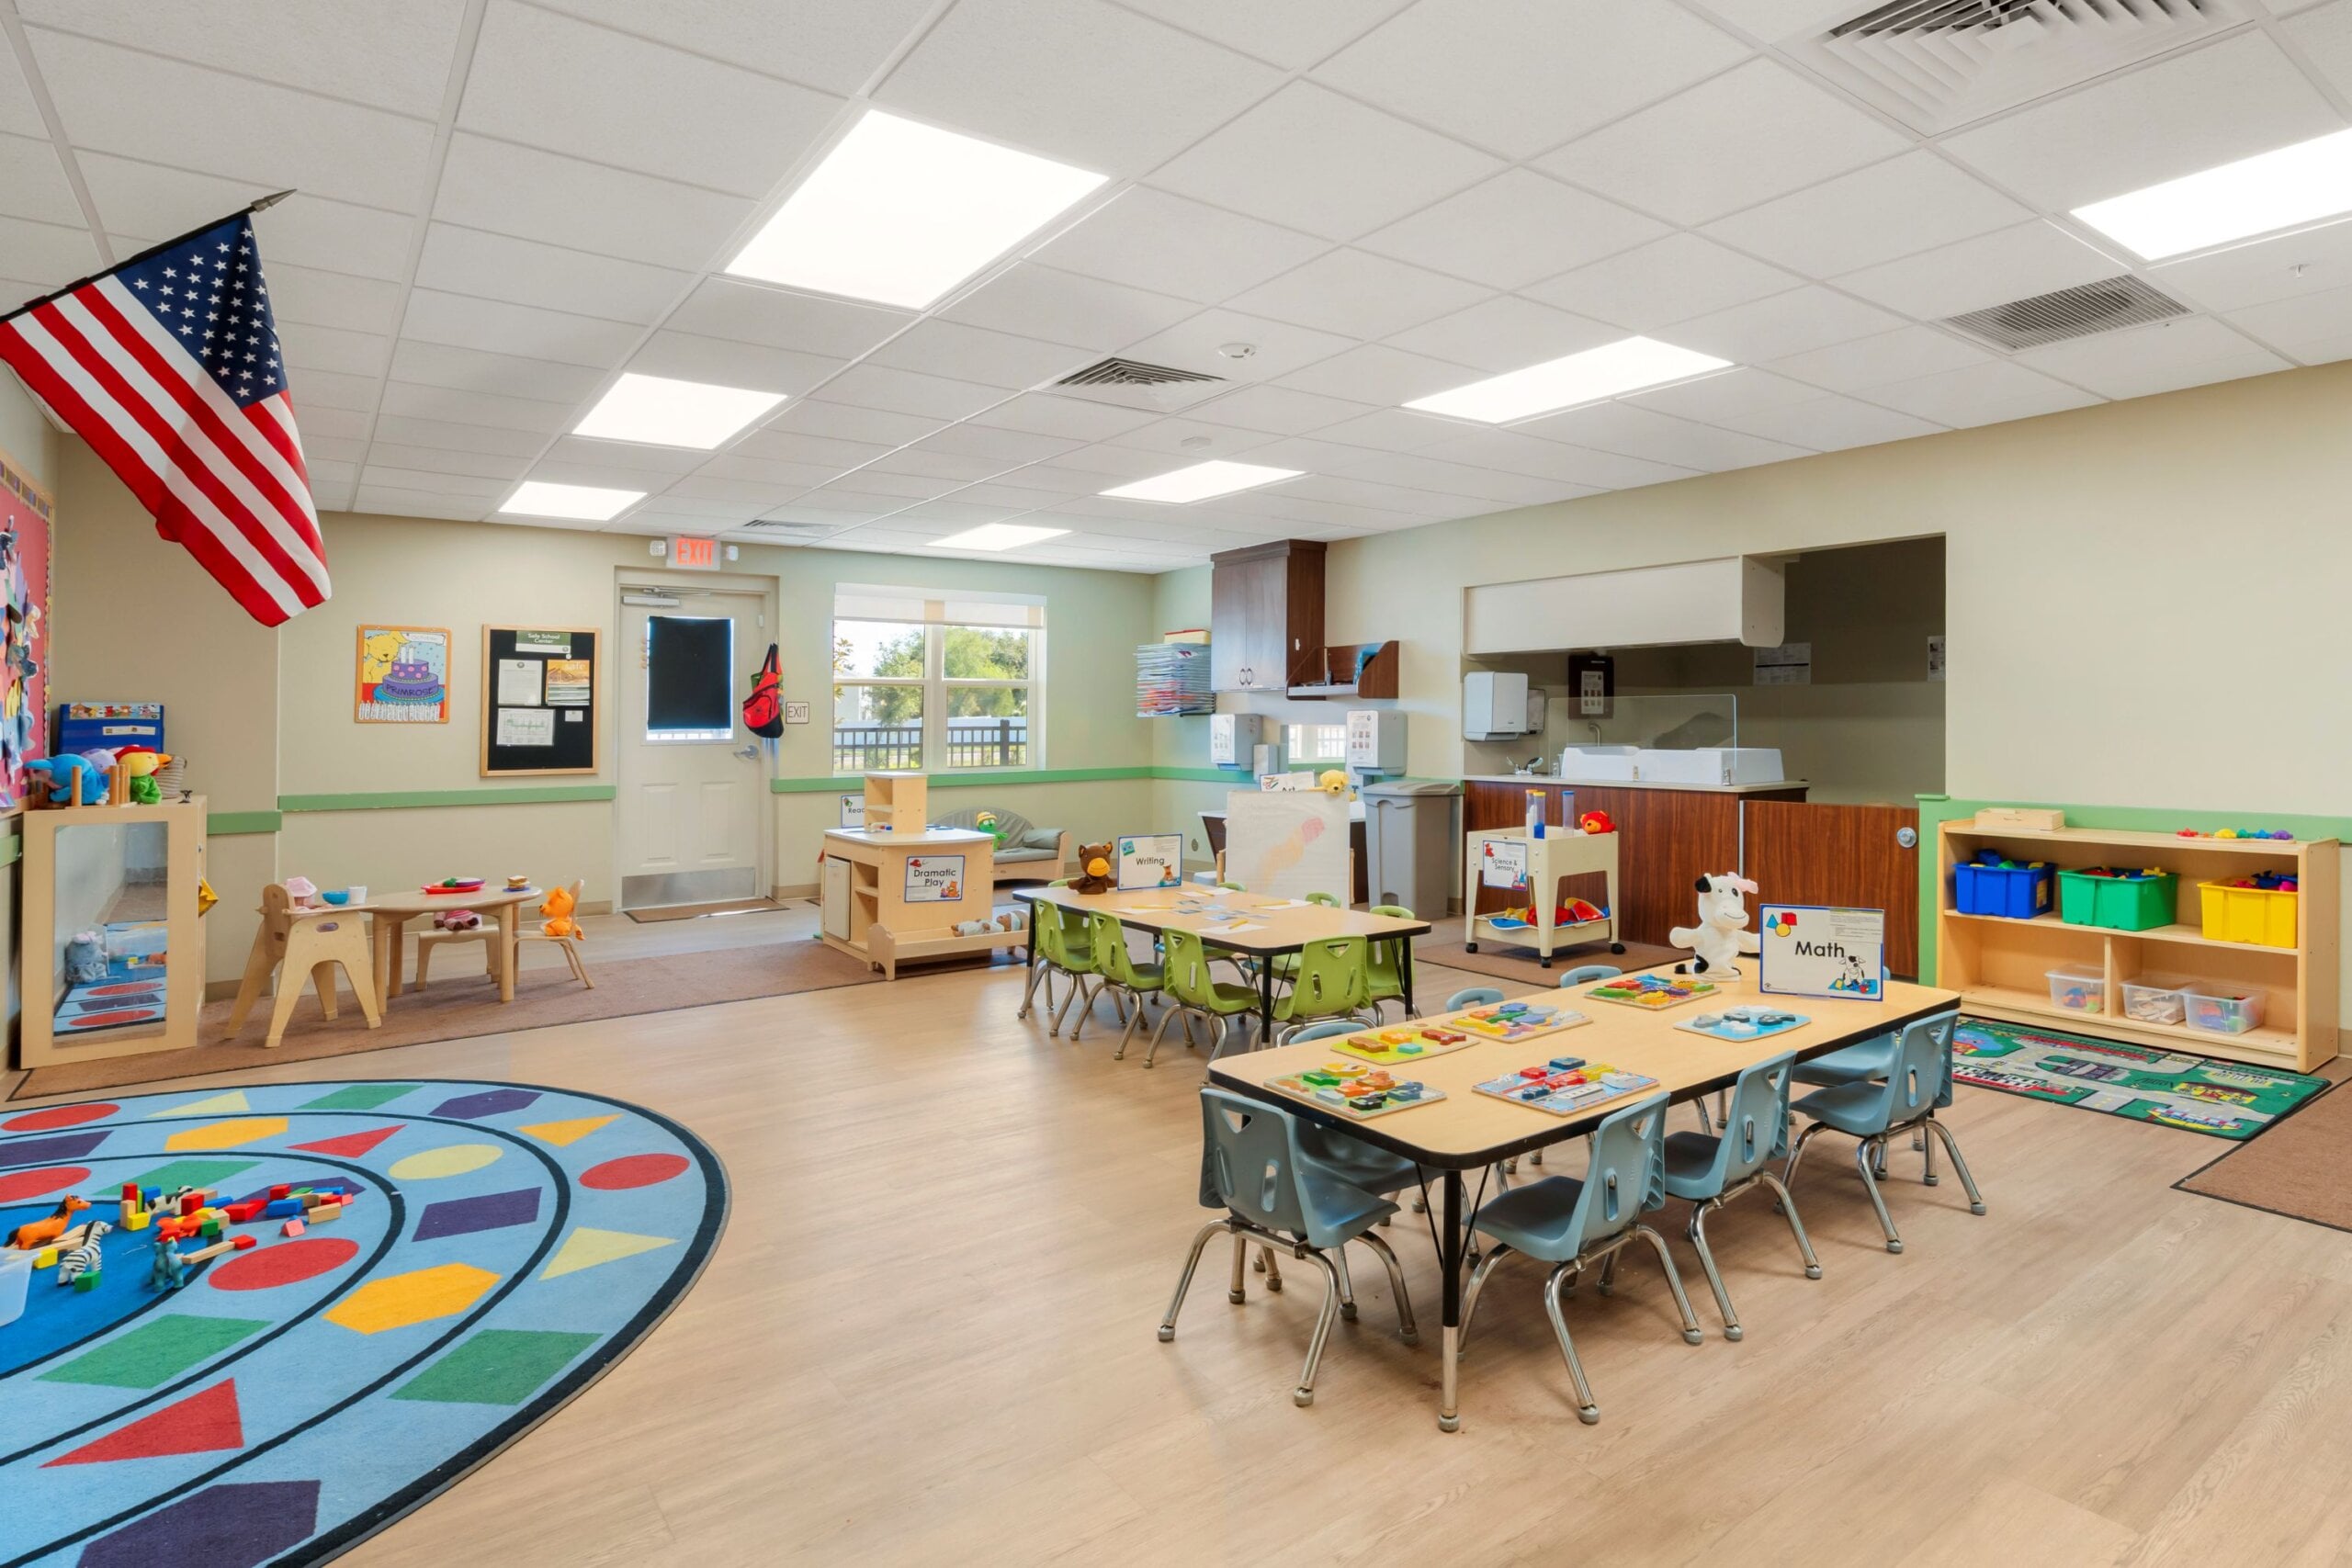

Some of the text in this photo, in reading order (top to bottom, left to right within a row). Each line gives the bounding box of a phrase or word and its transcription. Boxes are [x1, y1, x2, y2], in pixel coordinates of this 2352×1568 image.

[676, 537, 715, 567] EXIT
[386, 683, 435, 697] PRIMROSE
[787, 705, 808, 718] EXIT
[1136, 856, 1165, 866] Writing
[1491, 857, 1512, 866] Science
[913, 868, 956, 877] Dramatic
[1494, 864, 1515, 873] Sensory
[924, 878, 944, 887] Play
[1794, 941, 1846, 958] Math
